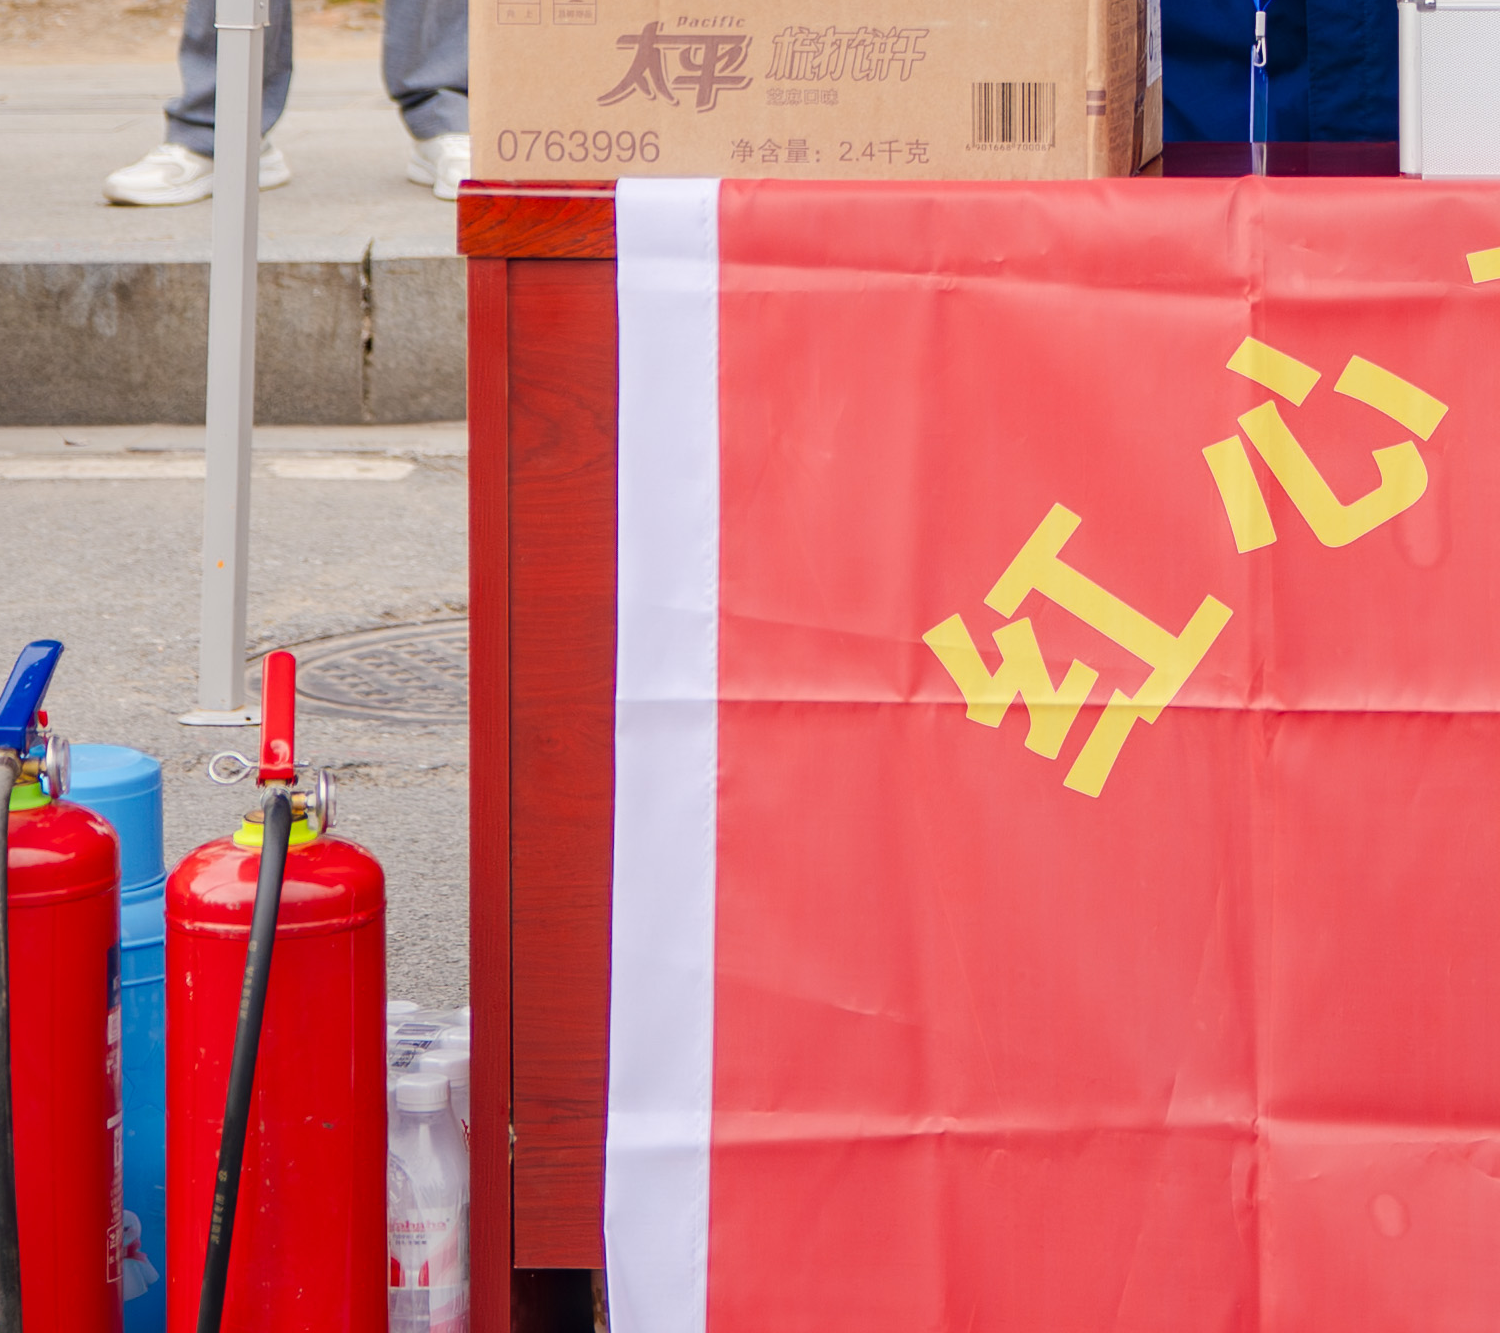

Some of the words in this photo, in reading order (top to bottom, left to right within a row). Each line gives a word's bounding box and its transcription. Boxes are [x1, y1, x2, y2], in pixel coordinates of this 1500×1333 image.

[676, 15, 746, 28] Pacific
[596, 21, 754, 114] 太平
[766, 88, 839, 106] 芝麻口味
[496, 129, 661, 164] 0763996
